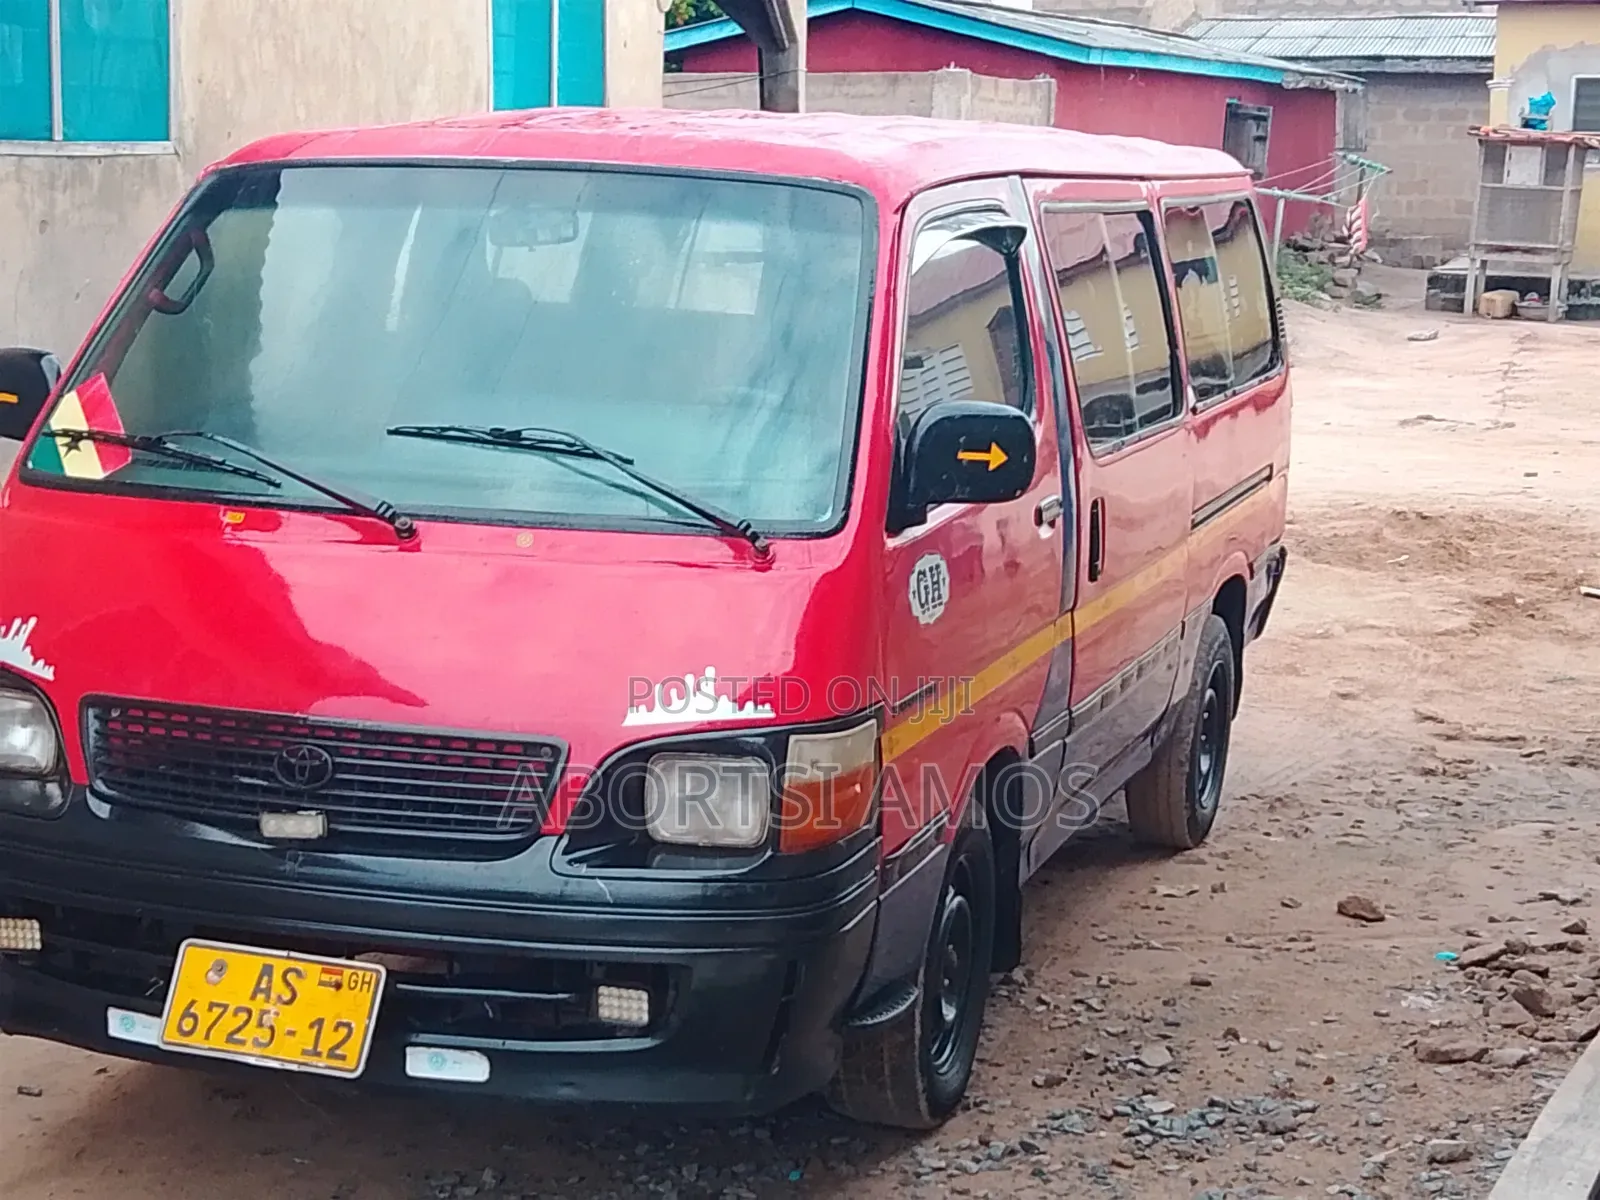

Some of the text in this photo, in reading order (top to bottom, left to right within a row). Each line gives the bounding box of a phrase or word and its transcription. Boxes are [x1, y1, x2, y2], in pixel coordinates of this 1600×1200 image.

[916, 562, 943, 610] GH
[250, 963, 306, 1006] AS
[347, 971, 372, 993] GH
[177, 1000, 354, 1061] 6725-12
